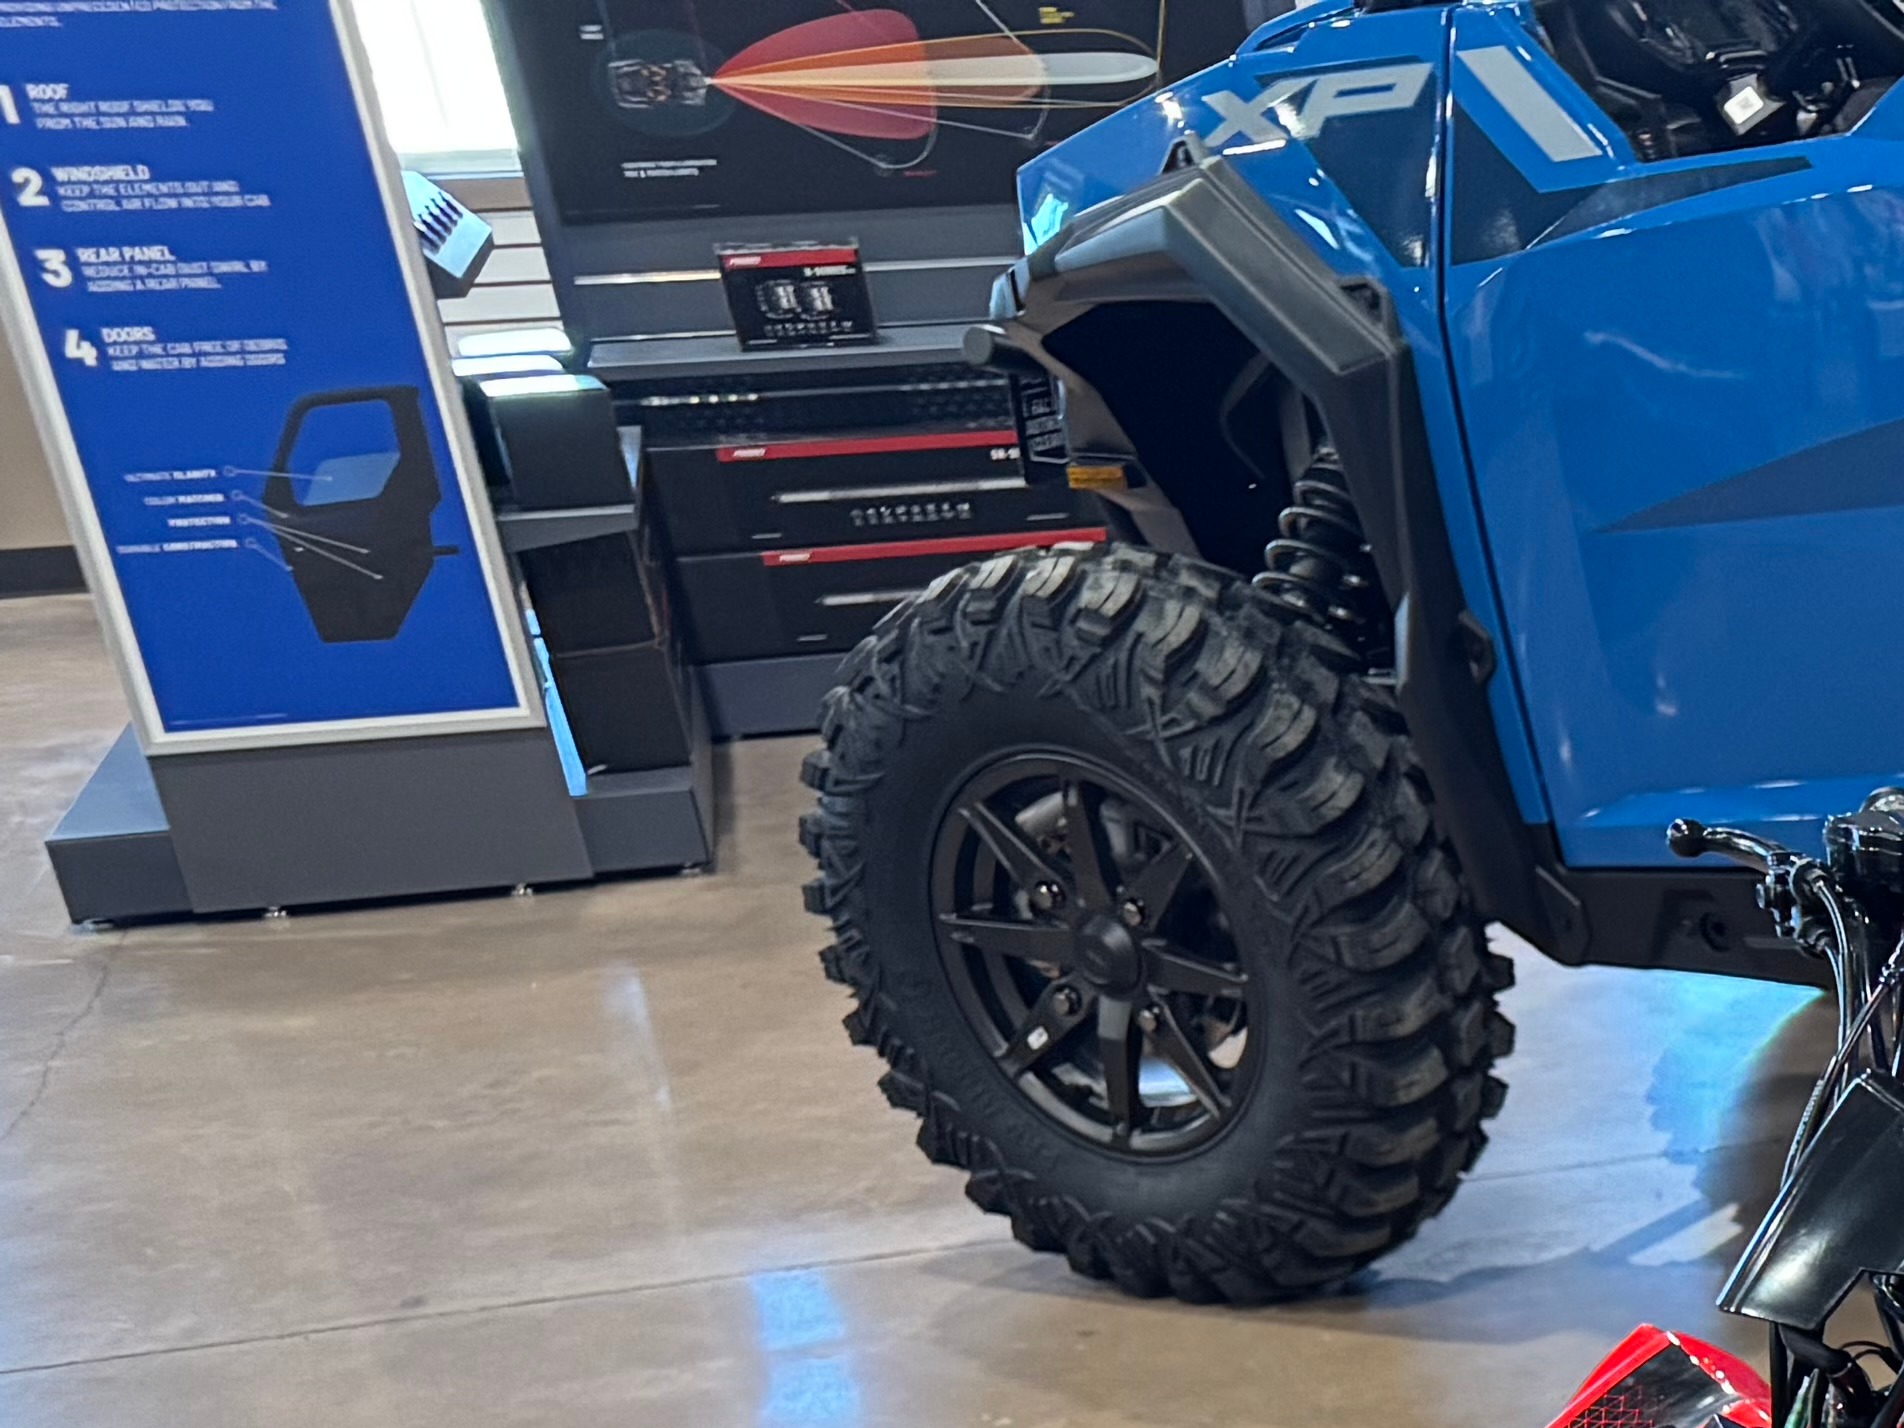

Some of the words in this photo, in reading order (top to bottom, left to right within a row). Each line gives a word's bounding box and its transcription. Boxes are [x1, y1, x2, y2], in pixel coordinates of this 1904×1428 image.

[0, 84, 21, 124] 1
[25, 83, 69, 100] ROOF
[1199, 62, 1434, 147] XP
[11, 167, 50, 207] 2
[50, 165, 150, 182] WINDSHIELD
[34, 248, 73, 288] 3
[76, 246, 122, 263] REAR
[122, 245, 176, 261] PANEL
[64, 328, 98, 367] 4
[101, 326, 156, 343] DOORS
